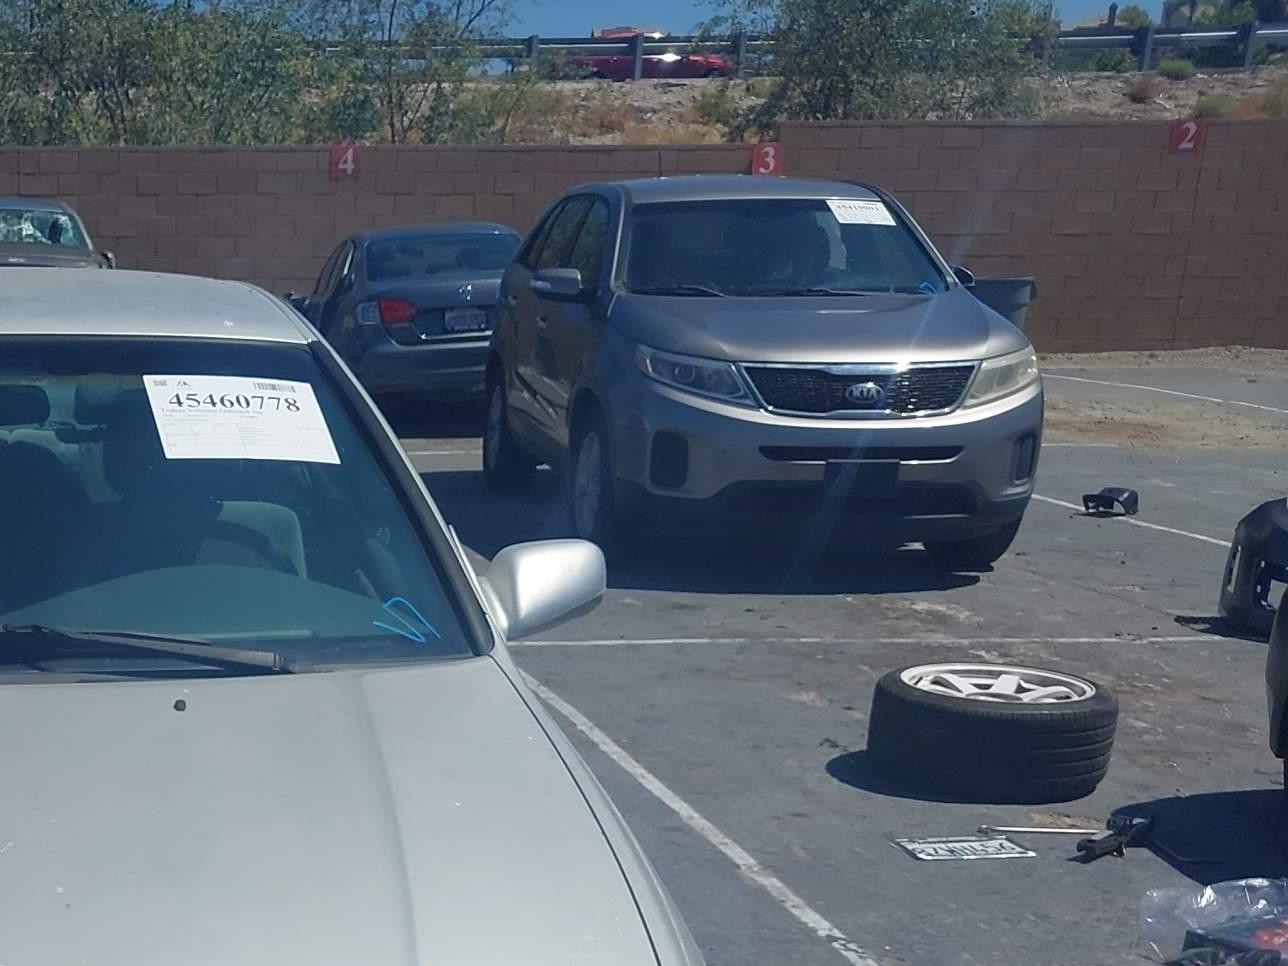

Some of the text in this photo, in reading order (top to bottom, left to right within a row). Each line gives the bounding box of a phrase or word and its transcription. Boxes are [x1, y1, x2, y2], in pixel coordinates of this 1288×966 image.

[1177, 122, 1198, 148] 2
[339, 147, 355, 174] 4
[759, 147, 776, 172] 3
[168, 393, 301, 413] 45460778
[851, 386, 878, 399] KIA
